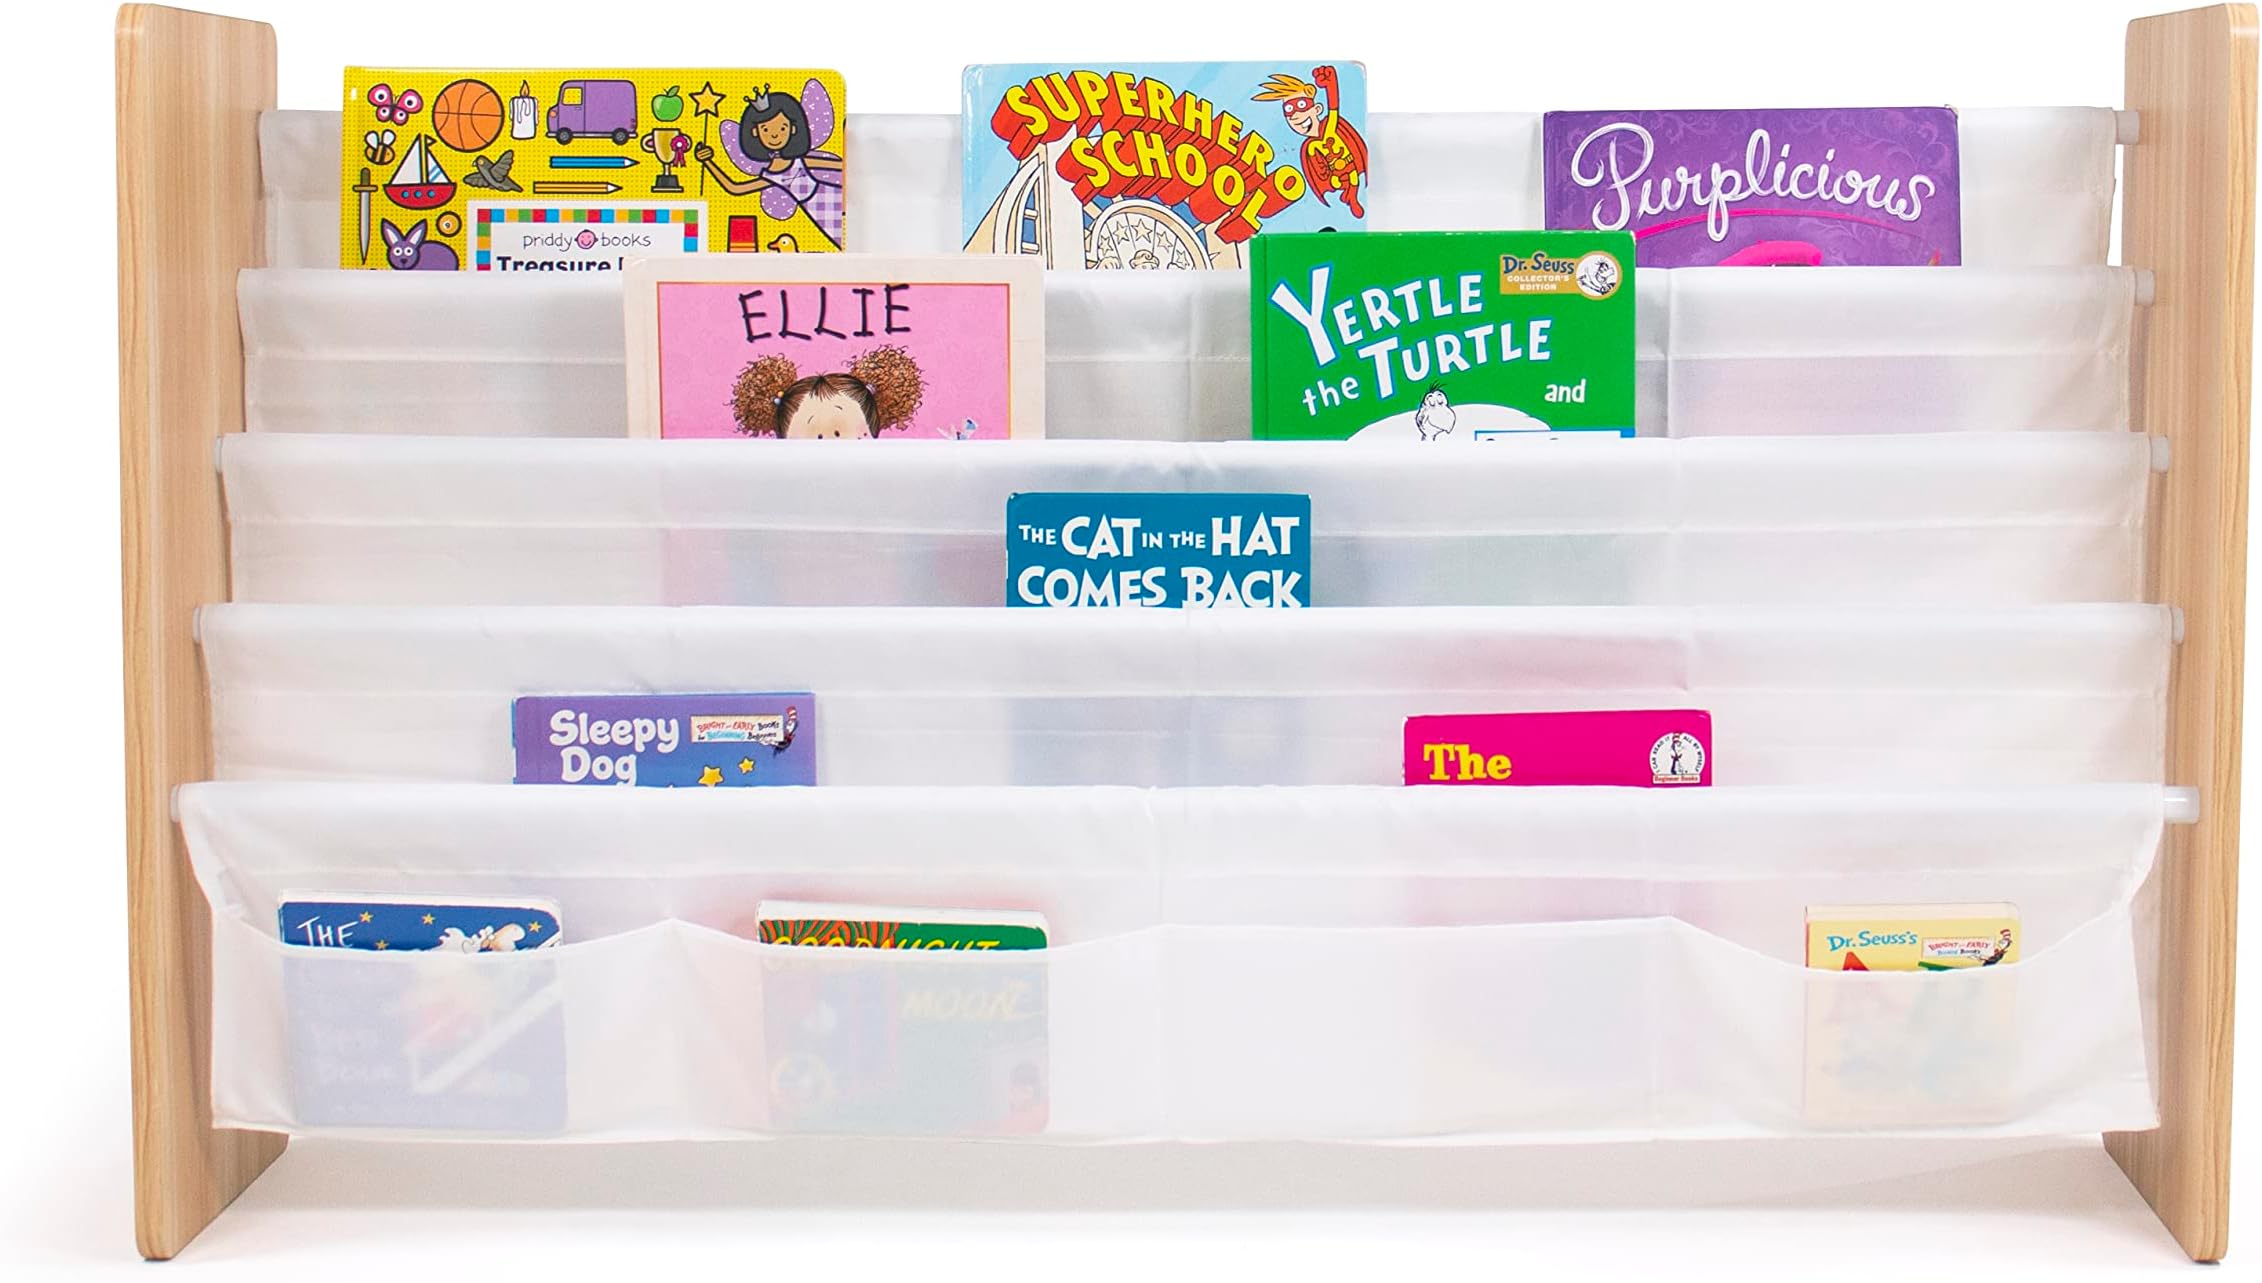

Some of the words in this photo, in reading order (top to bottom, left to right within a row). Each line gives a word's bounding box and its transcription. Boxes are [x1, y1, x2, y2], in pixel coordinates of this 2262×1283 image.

[1003, 70, 1306, 202] SUPERHERO
[1069, 131, 1267, 232] SCHOOL
[1571, 122, 1936, 242] Purplicious
[523, 233, 573, 252] priddy
[602, 232, 651, 247] books
[497, 256, 611, 271] Treasure
[1503, 255, 1527, 274] Dr.
[1531, 253, 1575, 274] Seuss
[1507, 275, 1570, 283] COLLECTOR'S
[738, 284, 912, 343] ELLIE
[1269, 262, 1484, 368] YERTLE
[1302, 376, 1360, 416] the
[1357, 318, 1553, 400] TURTLE
[1544, 378, 1587, 403] and
[1018, 524, 1057, 546] THE
[1061, 513, 1141, 560] CAT
[1142, 532, 1163, 549] IN
[1169, 531, 1206, 549] THE
[1211, 512, 1300, 557] HAT
[1017, 565, 1167, 608] COMES
[1180, 565, 1303, 608] BACK
[549, 709, 680, 754] Sleepy
[560, 745, 637, 787] Dog
[1423, 741, 1512, 781] The
[296, 915, 359, 948] THE
[1826, 935, 1856, 951] Dr.
[1858, 930, 1918, 948] Seuss's
